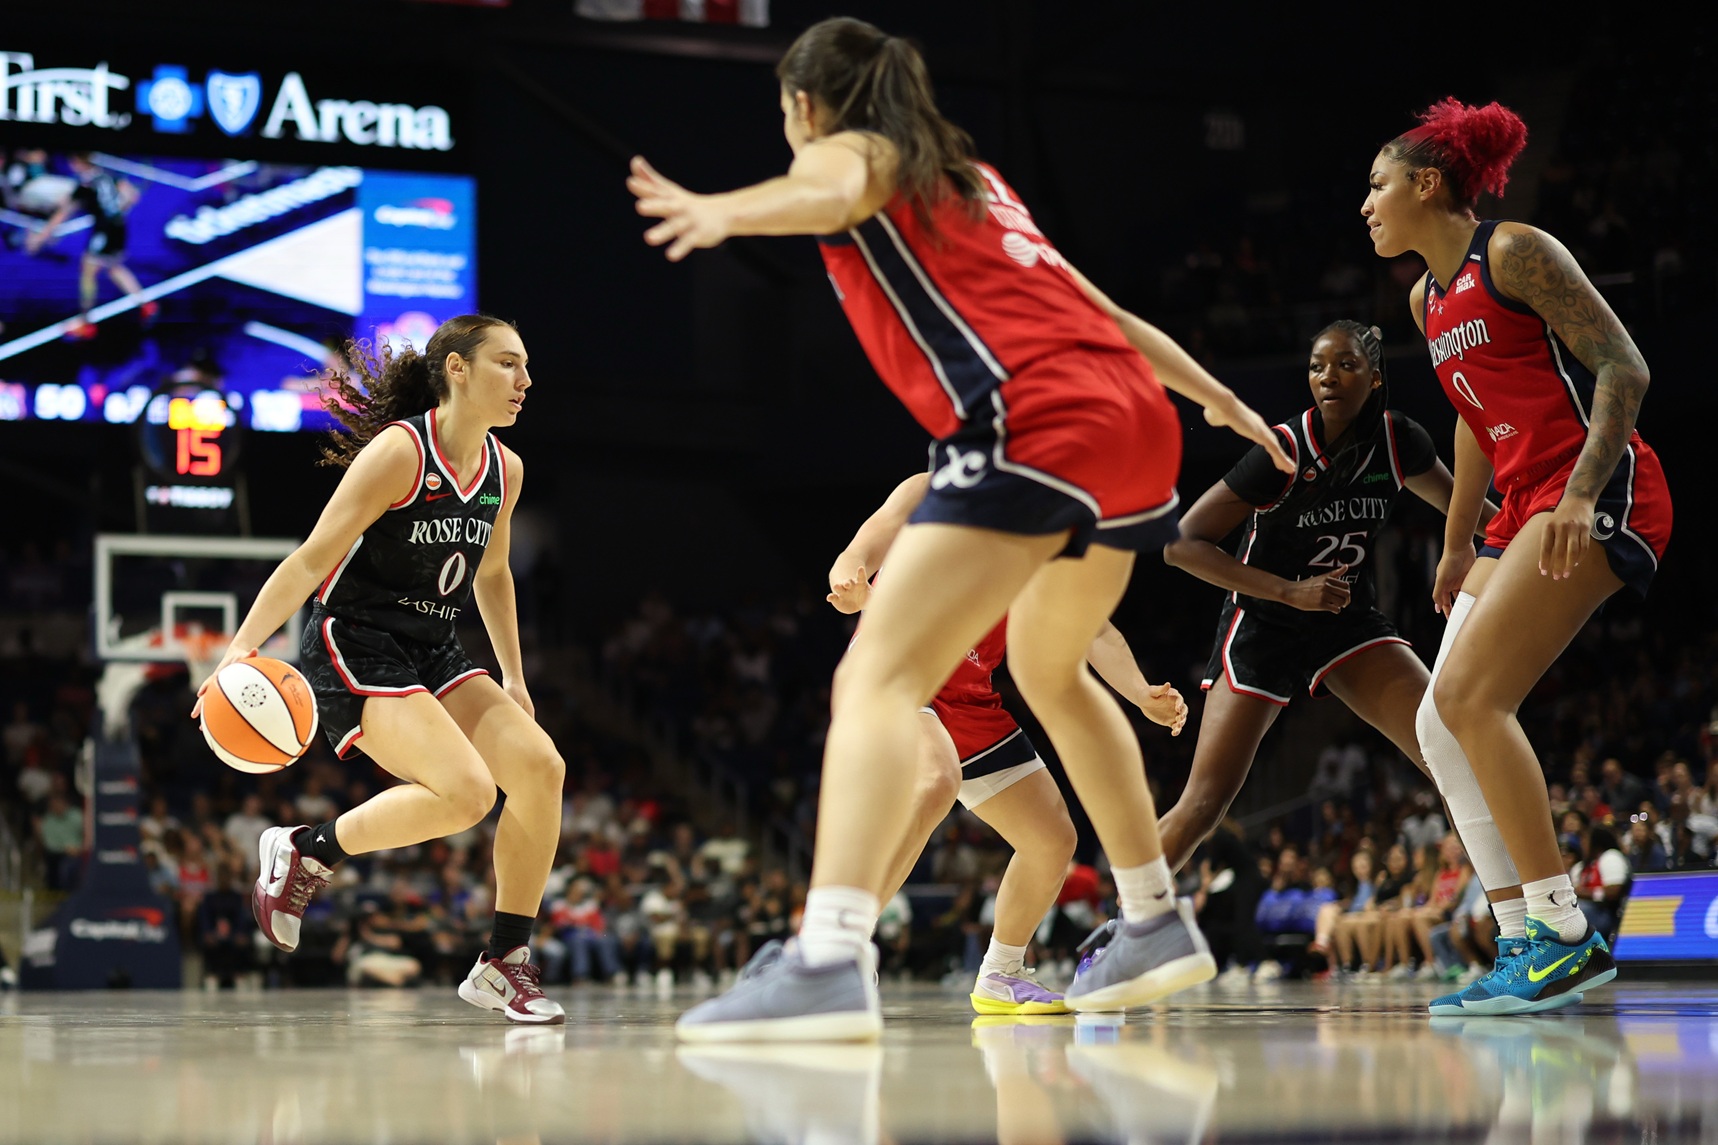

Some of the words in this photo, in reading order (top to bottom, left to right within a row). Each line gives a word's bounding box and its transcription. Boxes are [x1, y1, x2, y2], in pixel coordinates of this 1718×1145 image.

[262, 72, 455, 151] Arena
[1455, 280, 1476, 294] max
[1456, 272, 1472, 286] CAR
[1452, 371, 1485, 411] 0
[176, 427, 222, 476] 15
[1363, 472, 1390, 484] chime
[479, 493, 500, 505] chime
[1349, 497, 1388, 519] CITY
[408, 517, 463, 545] ROSE
[1307, 531, 1368, 568] 25
[438, 551, 466, 596] 0
